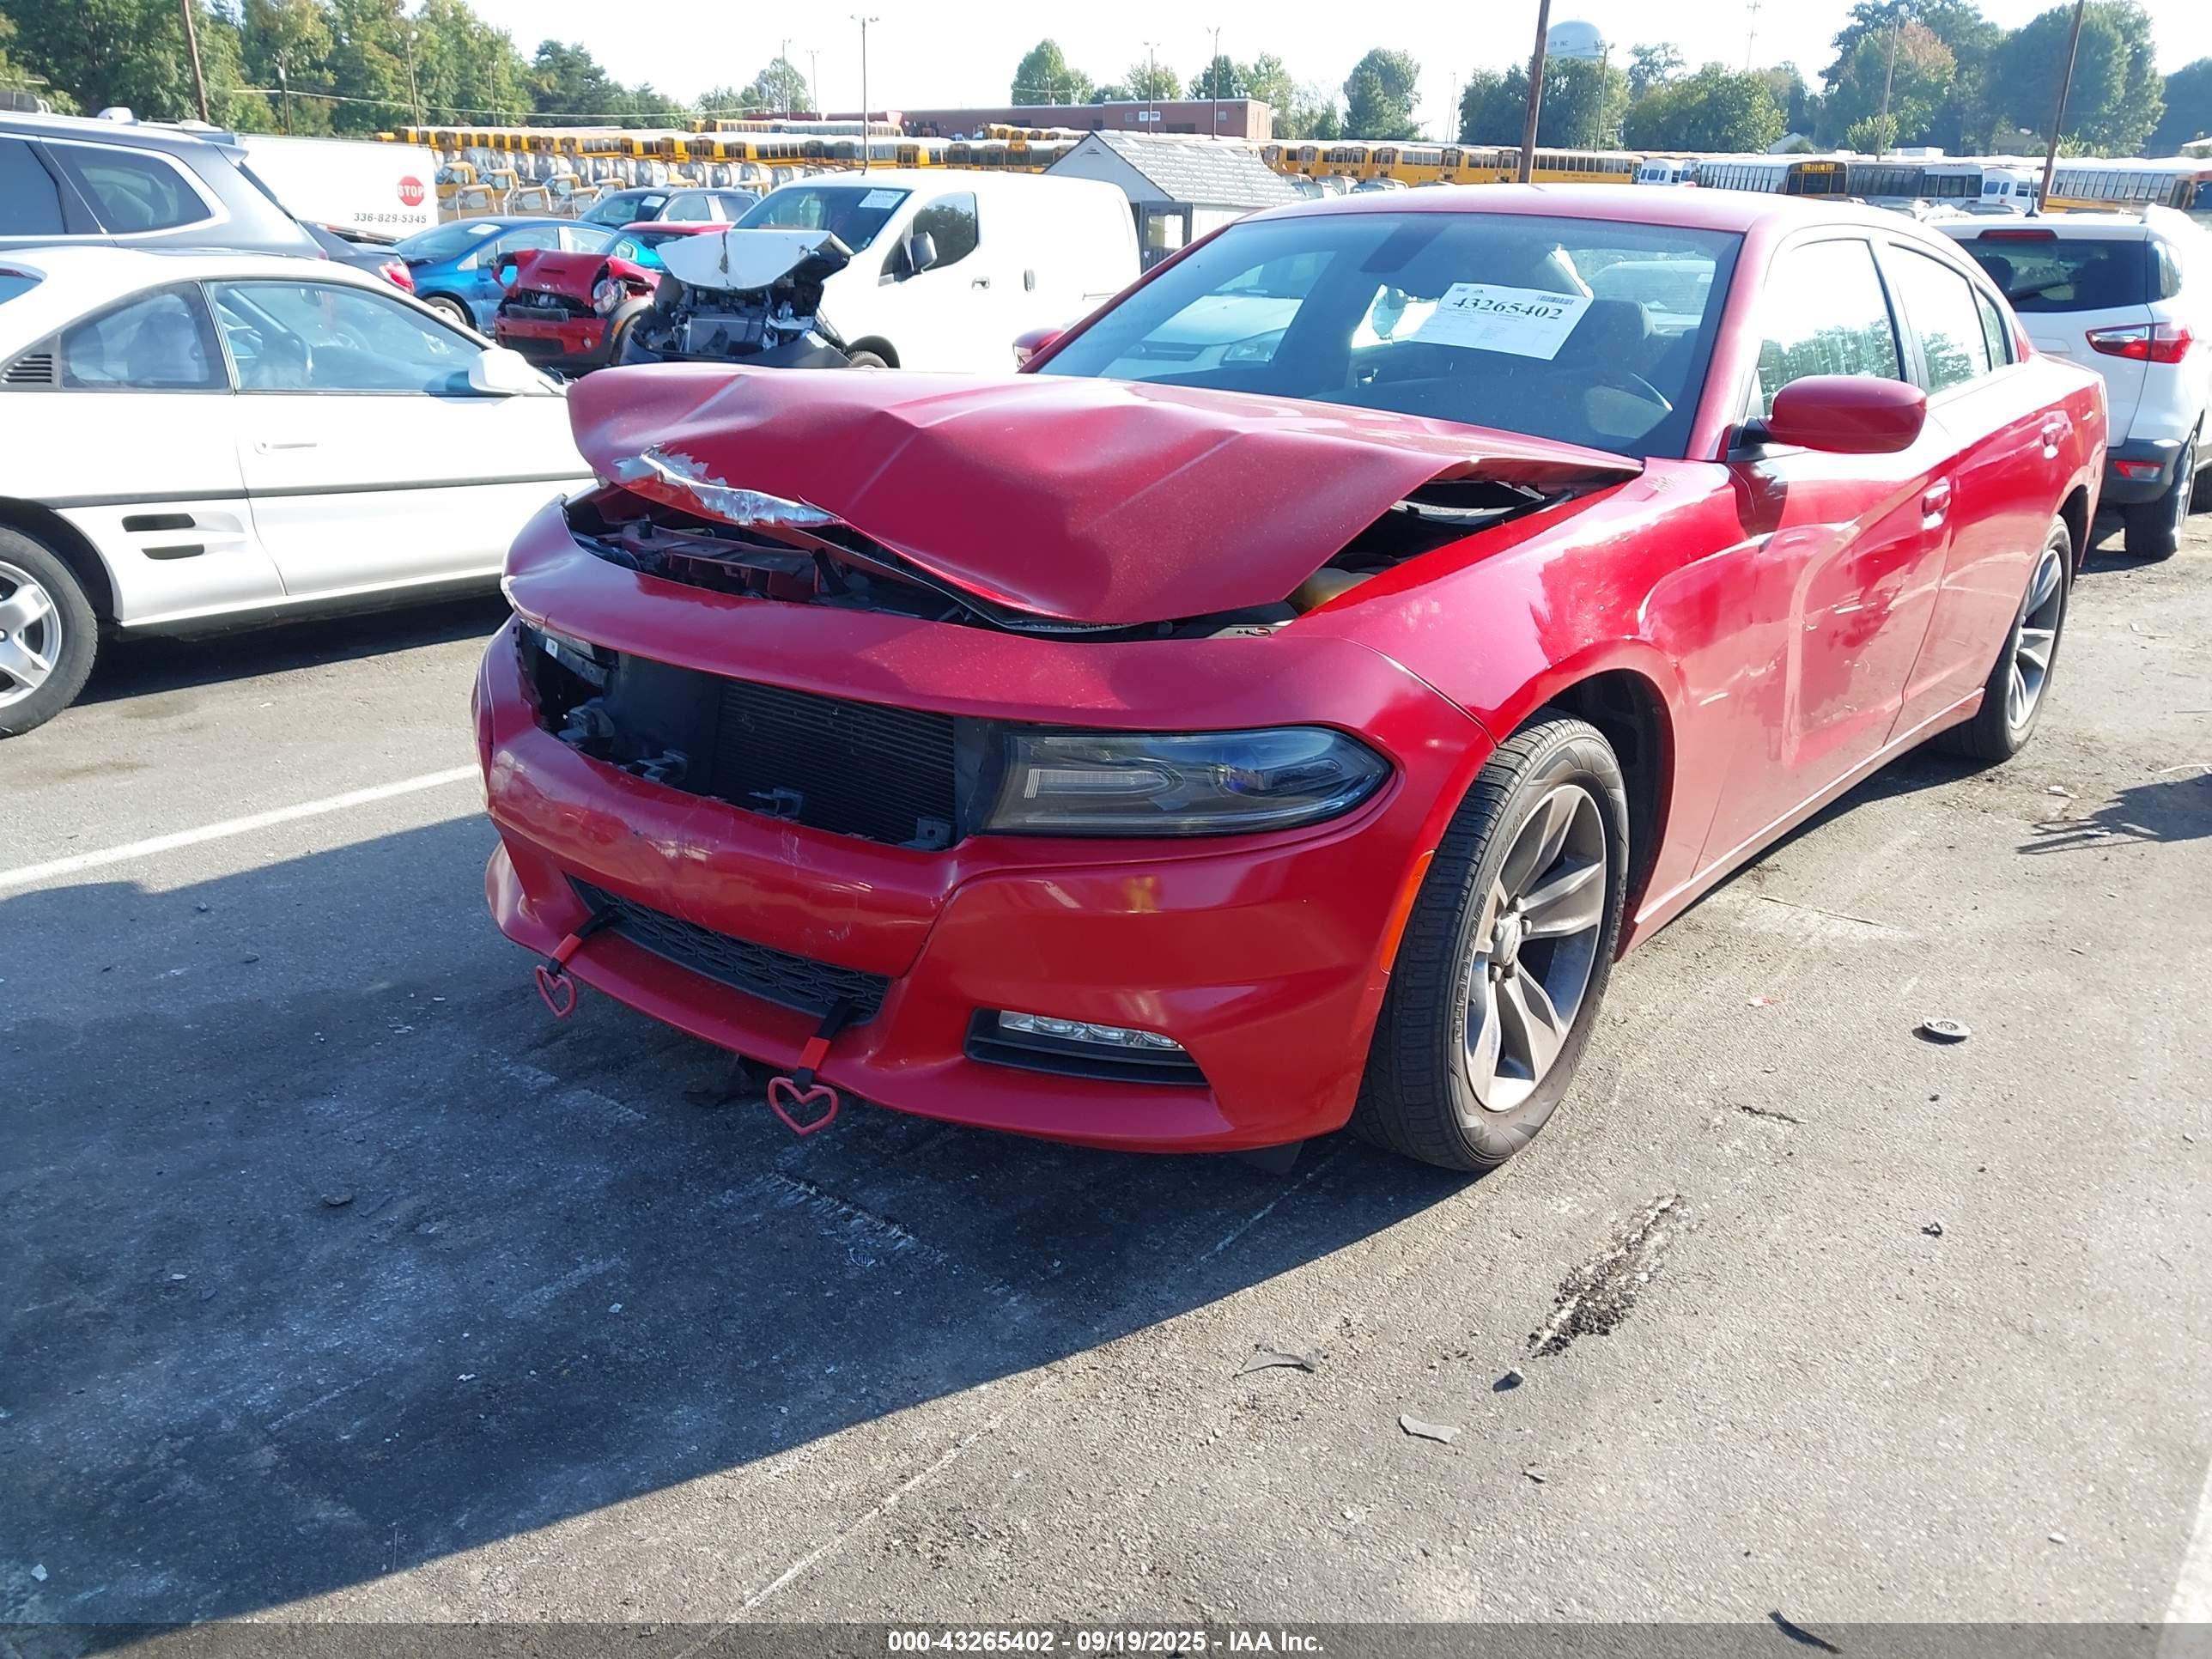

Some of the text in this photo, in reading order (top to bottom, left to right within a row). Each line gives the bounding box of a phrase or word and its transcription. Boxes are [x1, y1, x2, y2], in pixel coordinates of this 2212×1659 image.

[398, 185, 424, 198] STOP
[354, 212, 427, 223] 336-829-5345
[1453, 297, 1564, 320] 43265402
